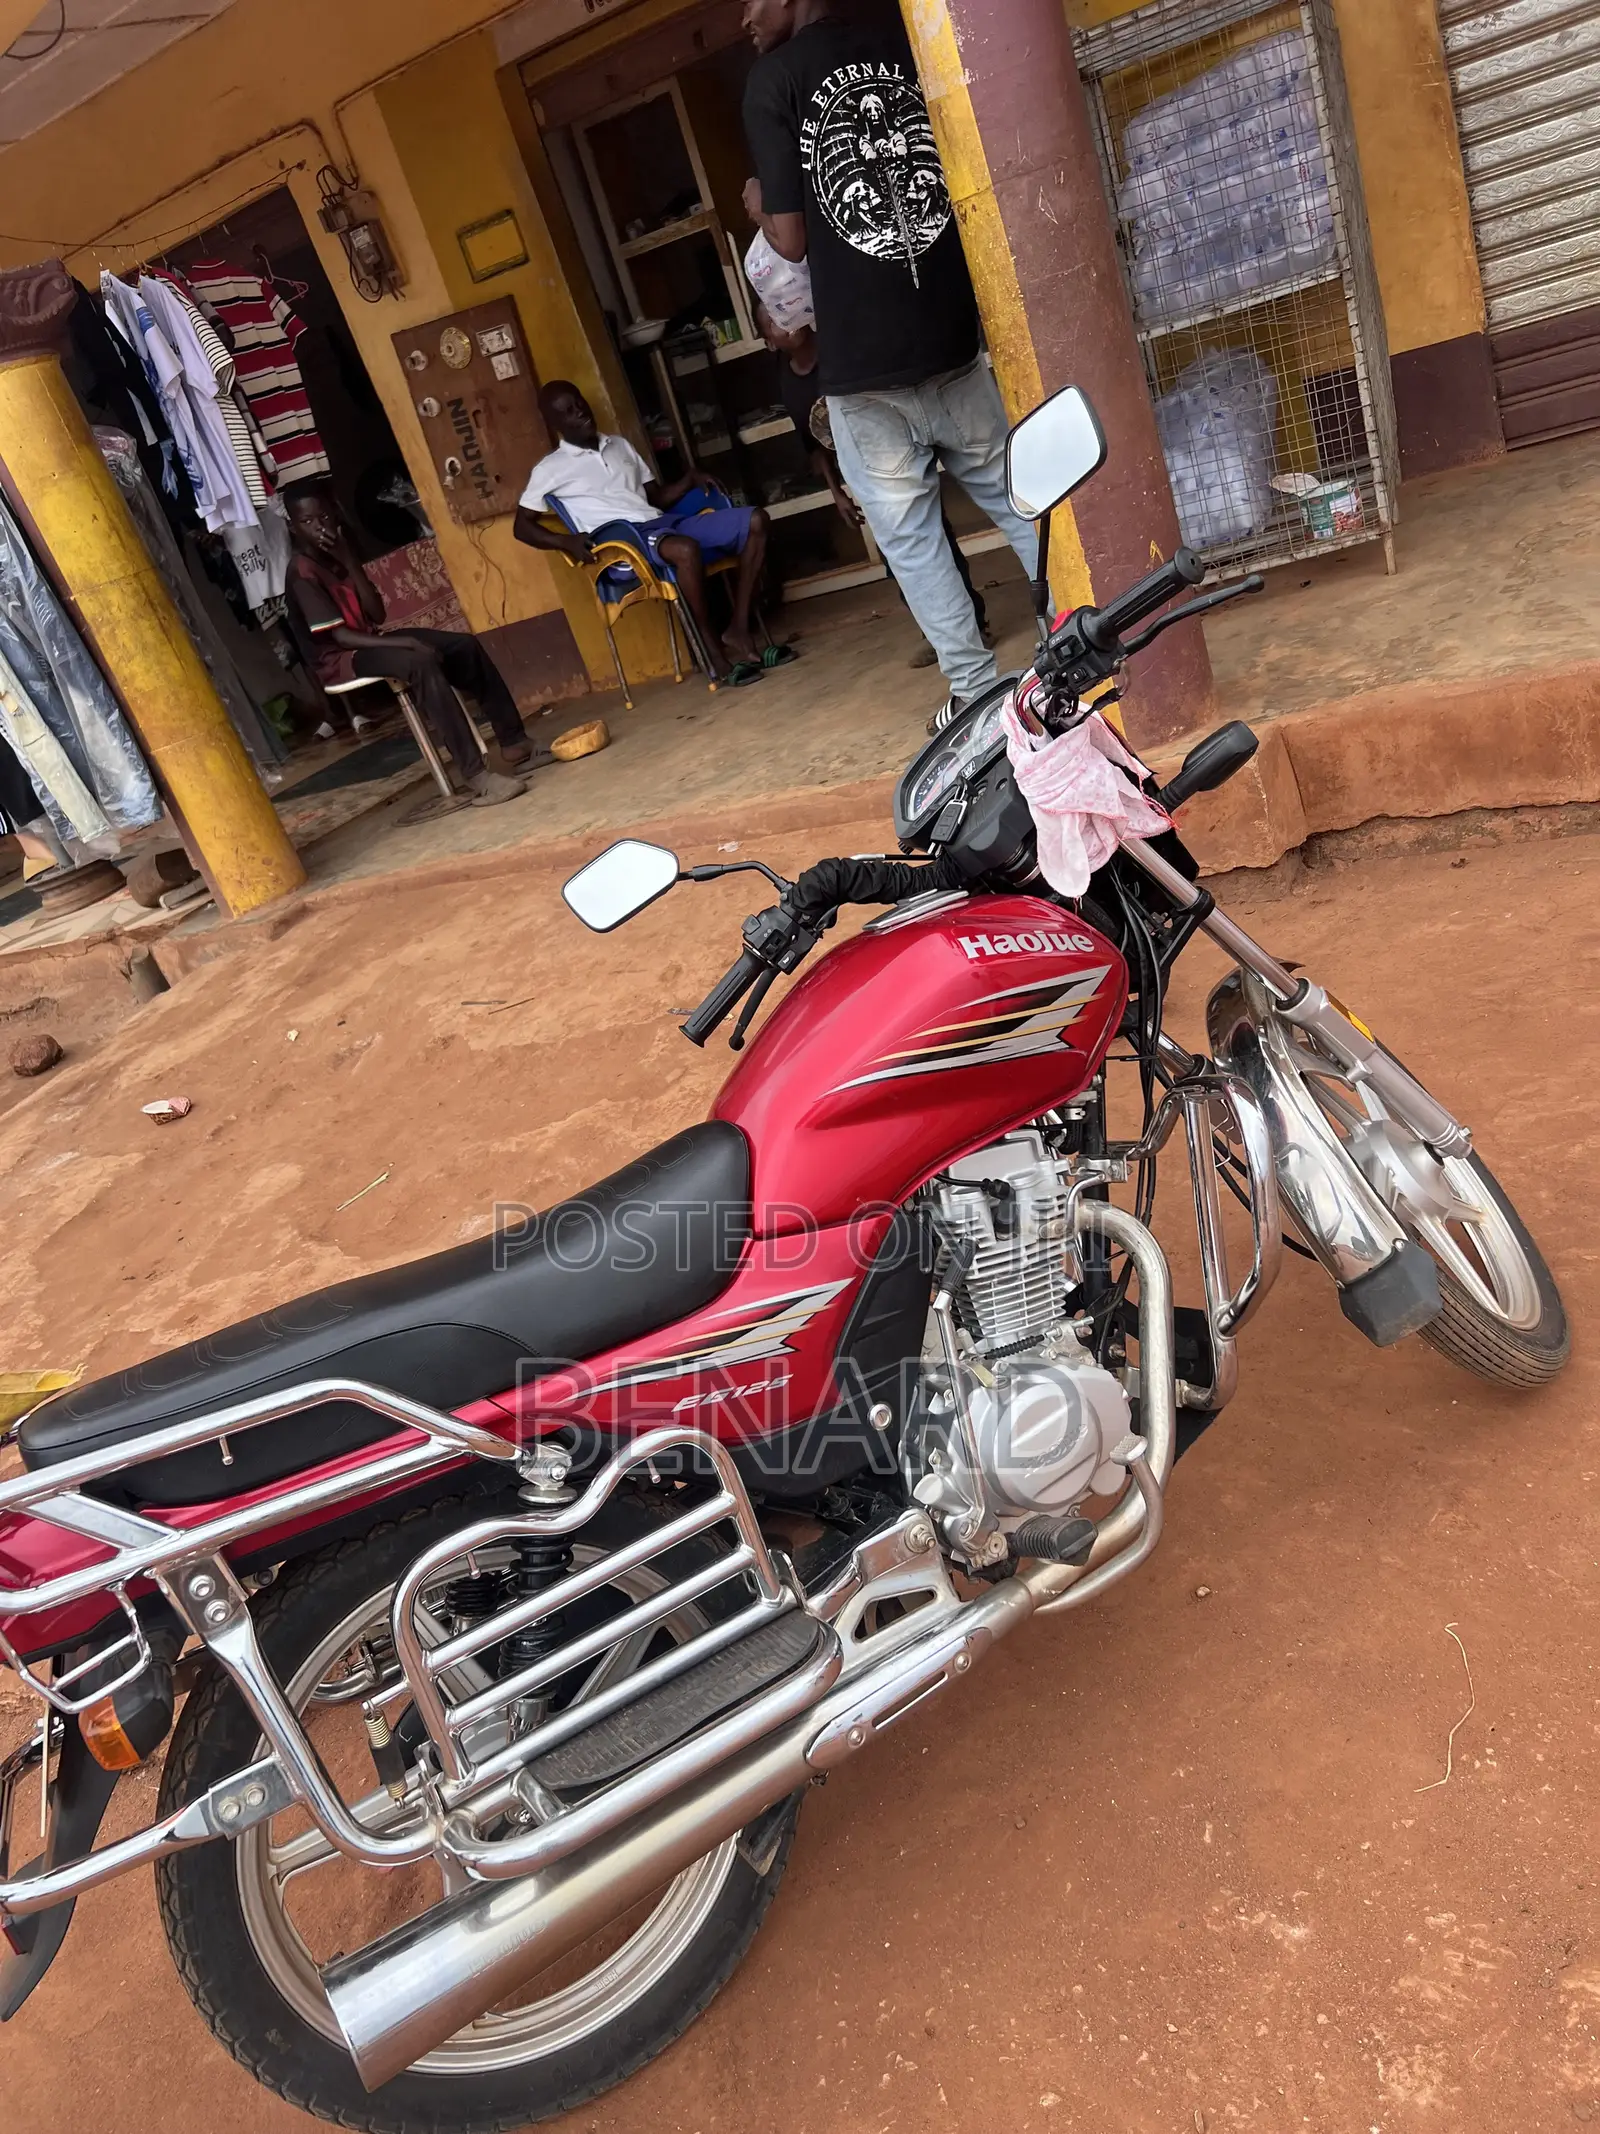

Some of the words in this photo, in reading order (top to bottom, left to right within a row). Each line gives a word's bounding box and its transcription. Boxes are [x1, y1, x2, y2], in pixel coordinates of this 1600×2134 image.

[811, 62, 905, 108] ETERNAL
[957, 930, 1095, 959] Haojue
[671, 1374, 794, 1412] EG125
